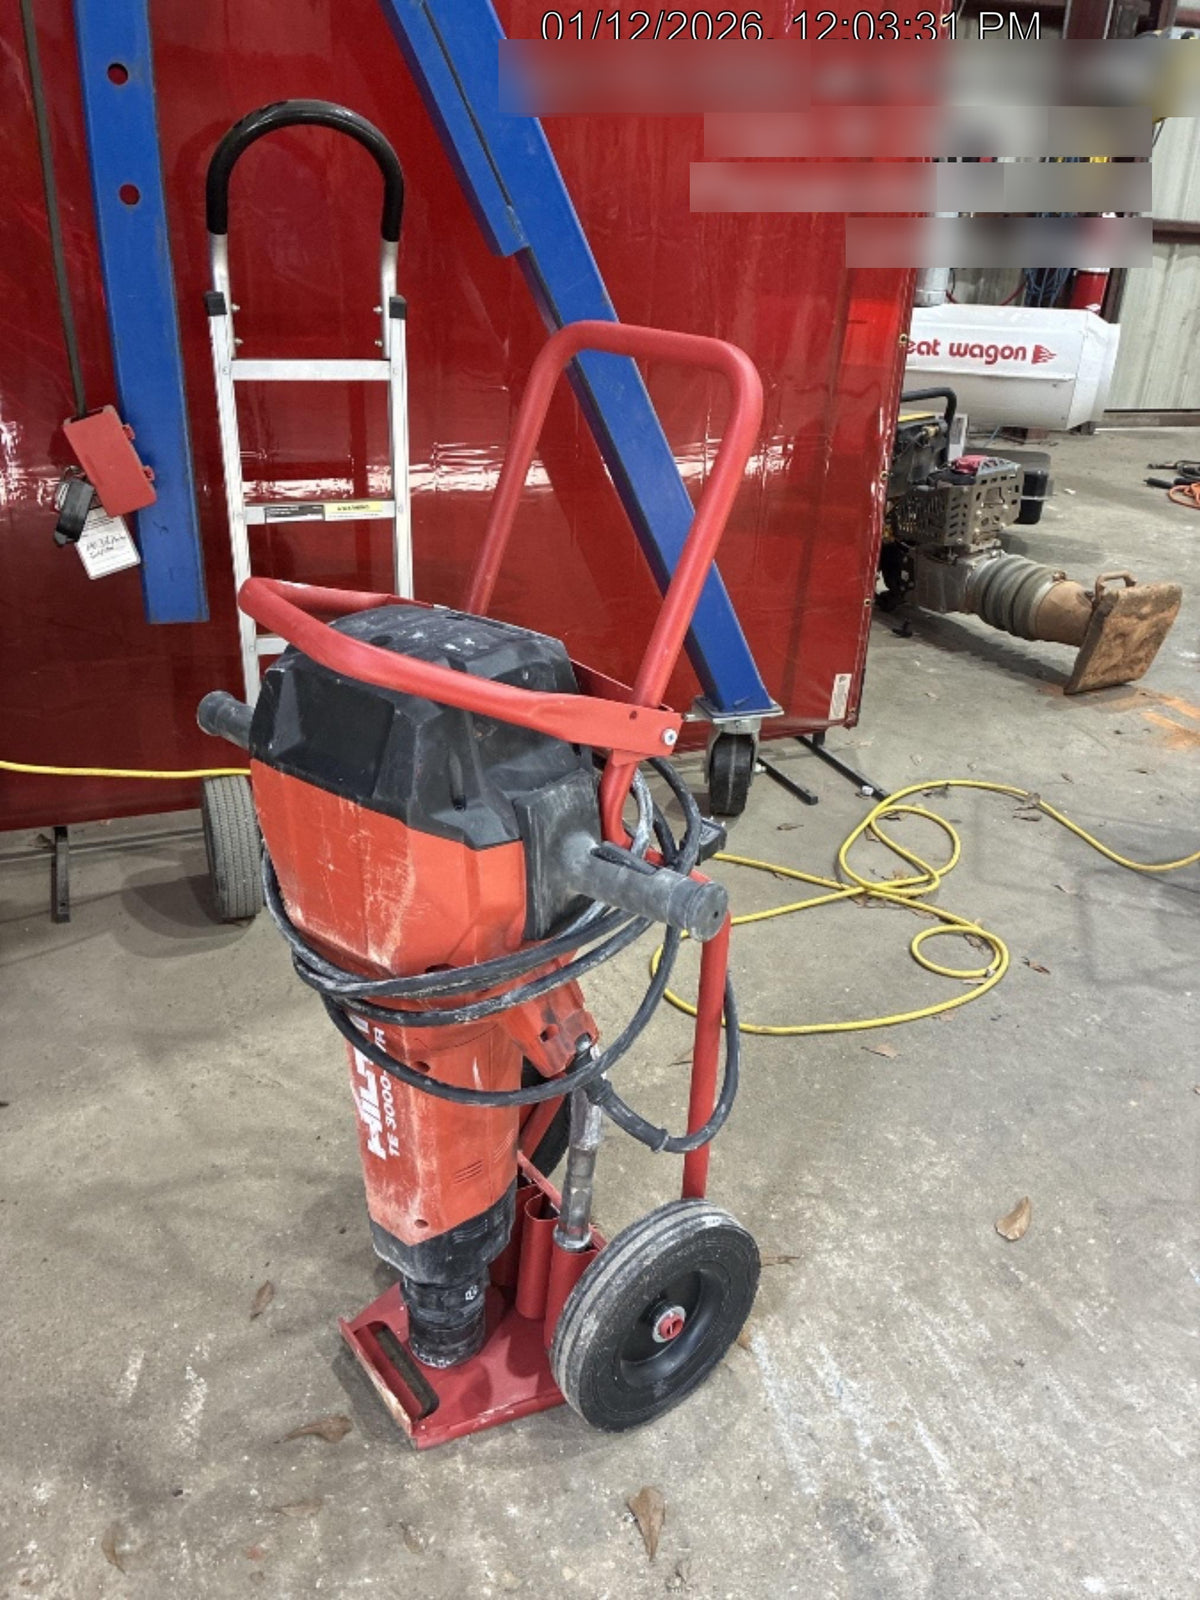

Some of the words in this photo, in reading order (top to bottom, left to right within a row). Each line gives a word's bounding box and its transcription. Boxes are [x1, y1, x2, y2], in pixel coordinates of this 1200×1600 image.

[905, 338, 941, 356] eat
[949, 343, 1027, 365] wagon
[350, 1015, 387, 1160] HILTI
[387, 1133, 400, 1157] TE
